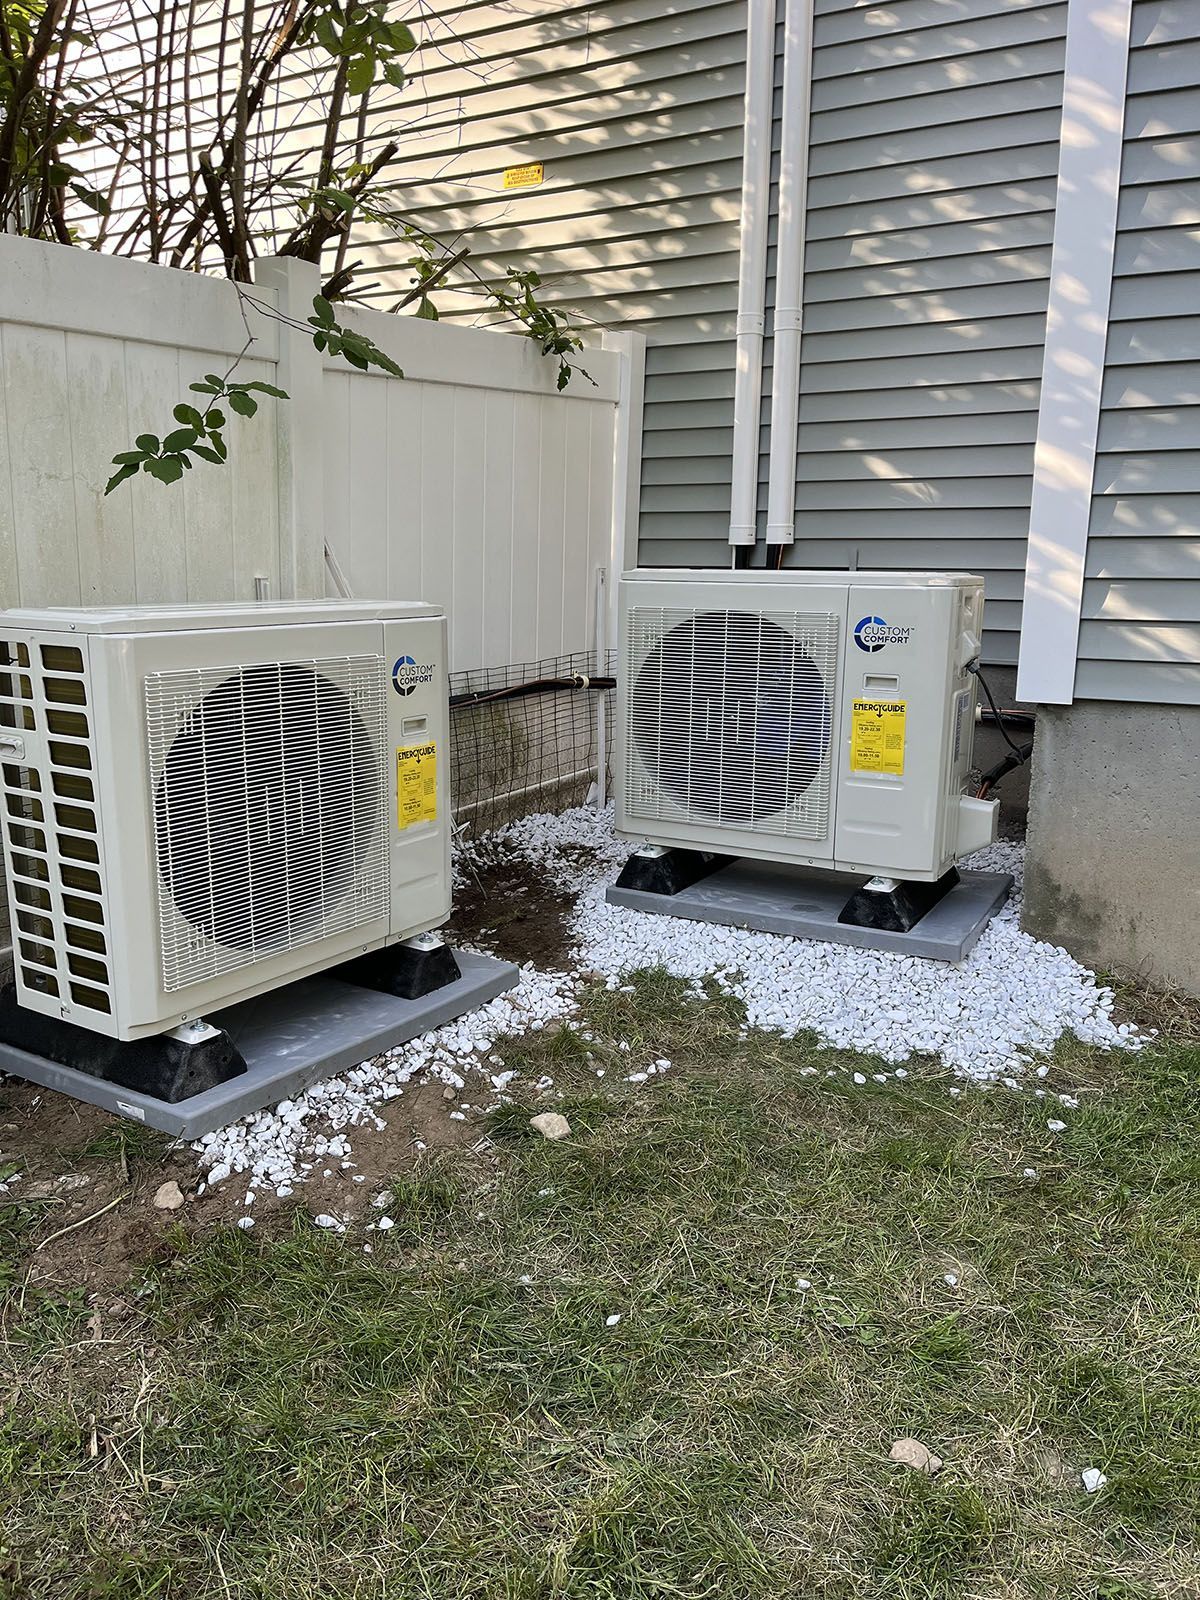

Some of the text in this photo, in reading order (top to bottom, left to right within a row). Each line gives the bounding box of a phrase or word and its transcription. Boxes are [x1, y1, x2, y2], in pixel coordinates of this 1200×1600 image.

[864, 635, 908, 644] COMFORT
[400, 674, 433, 686] COMFORT
[853, 703, 906, 713] ENERGYGUIDE
[397, 745, 436, 761] ENERGYGUIDE
